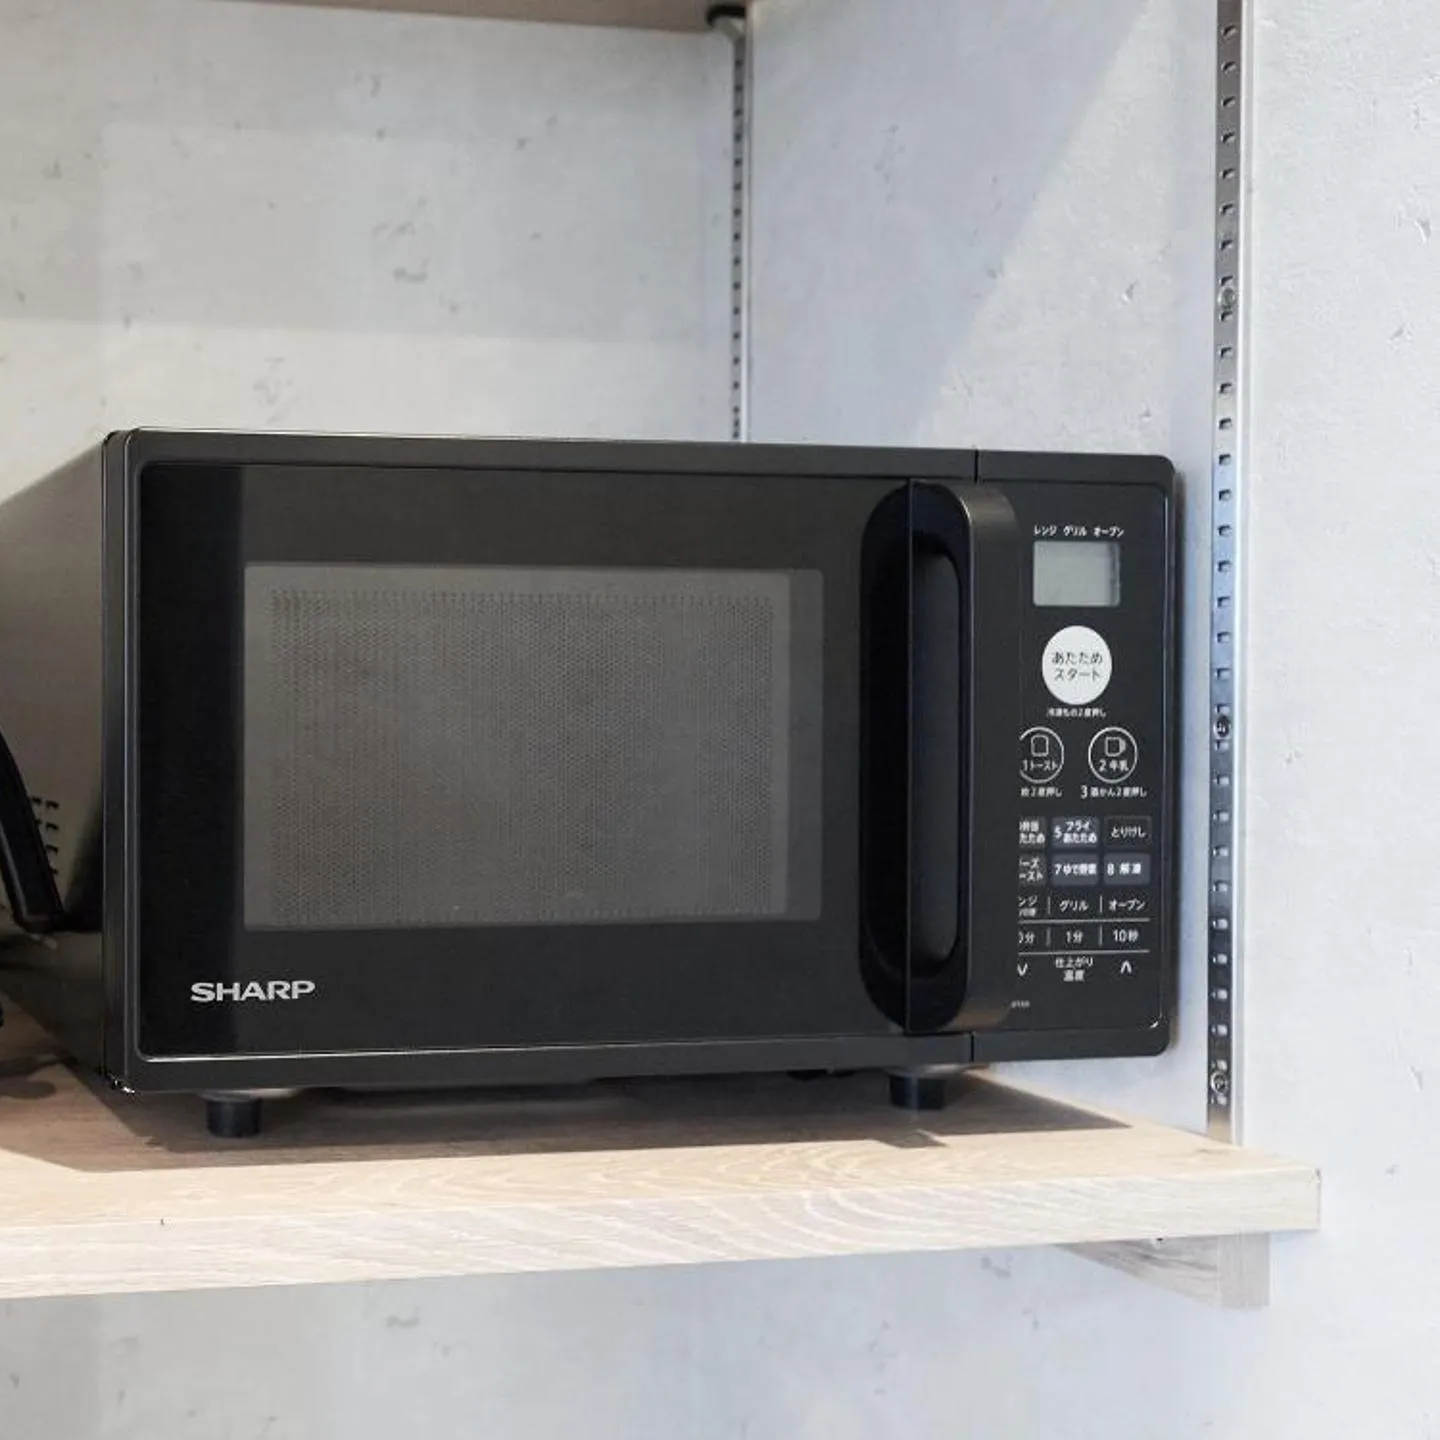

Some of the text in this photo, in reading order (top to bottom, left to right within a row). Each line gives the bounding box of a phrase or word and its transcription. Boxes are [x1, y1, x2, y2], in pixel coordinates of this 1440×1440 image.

[1034, 525, 1125, 538] レンジ グリル オープン
[1051, 651, 1103, 665] あたため
[1054, 668, 1102, 681] スタート
[1065, 820, 1091, 832] フライ
[1111, 826, 1147, 838] とりけし
[1063, 833, 1098, 844] あたため
[1019, 857, 1040, 869] ーズ
[1060, 897, 1147, 912] グリル オープン
[190, 980, 316, 1002] SHARP
